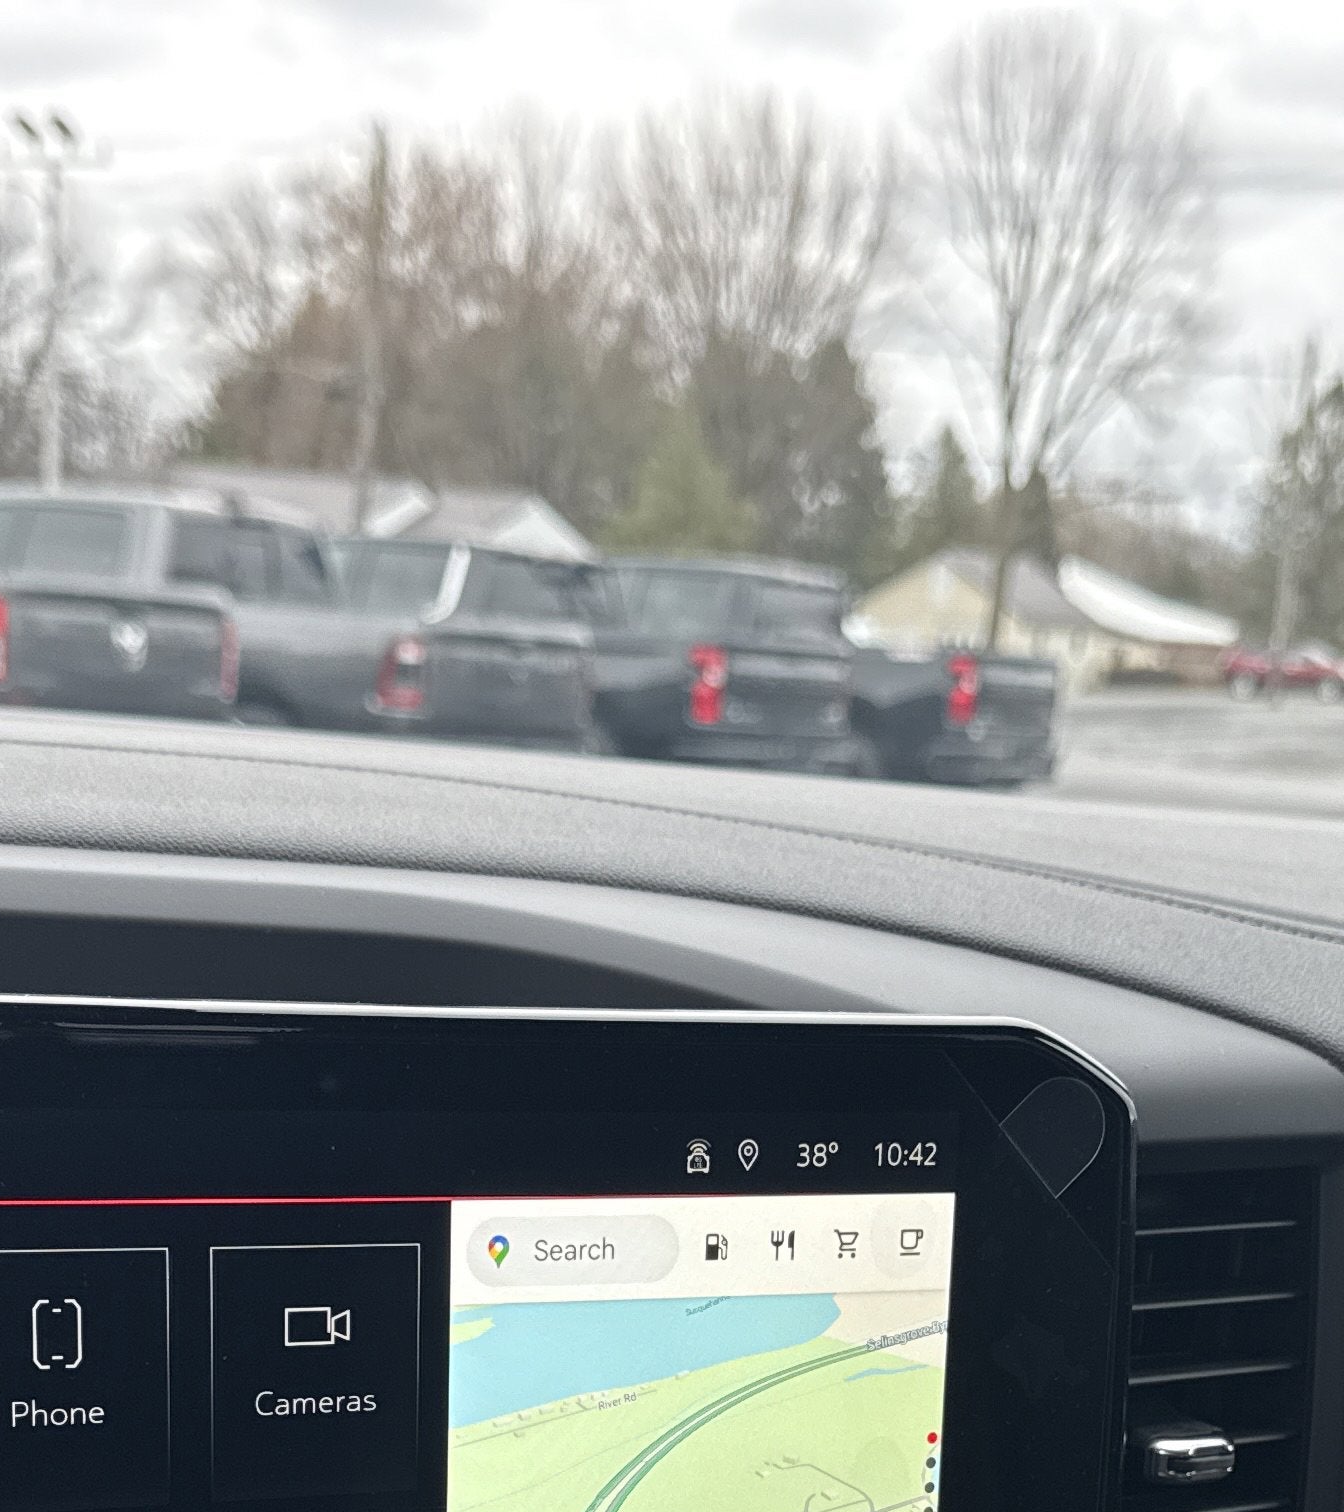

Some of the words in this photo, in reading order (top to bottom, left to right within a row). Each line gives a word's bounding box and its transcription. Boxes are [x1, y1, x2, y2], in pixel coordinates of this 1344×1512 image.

[796, 1141, 839, 1168] 38°
[874, 1142, 937, 1167] 10:42
[534, 1237, 615, 1261] Search
[865, 1325, 930, 1352] Selinsgrove
[11, 1399, 105, 1428] Phone
[255, 1390, 377, 1416] Cameras
[598, 1398, 621, 1411] River
[623, 1392, 637, 1403] Rd
